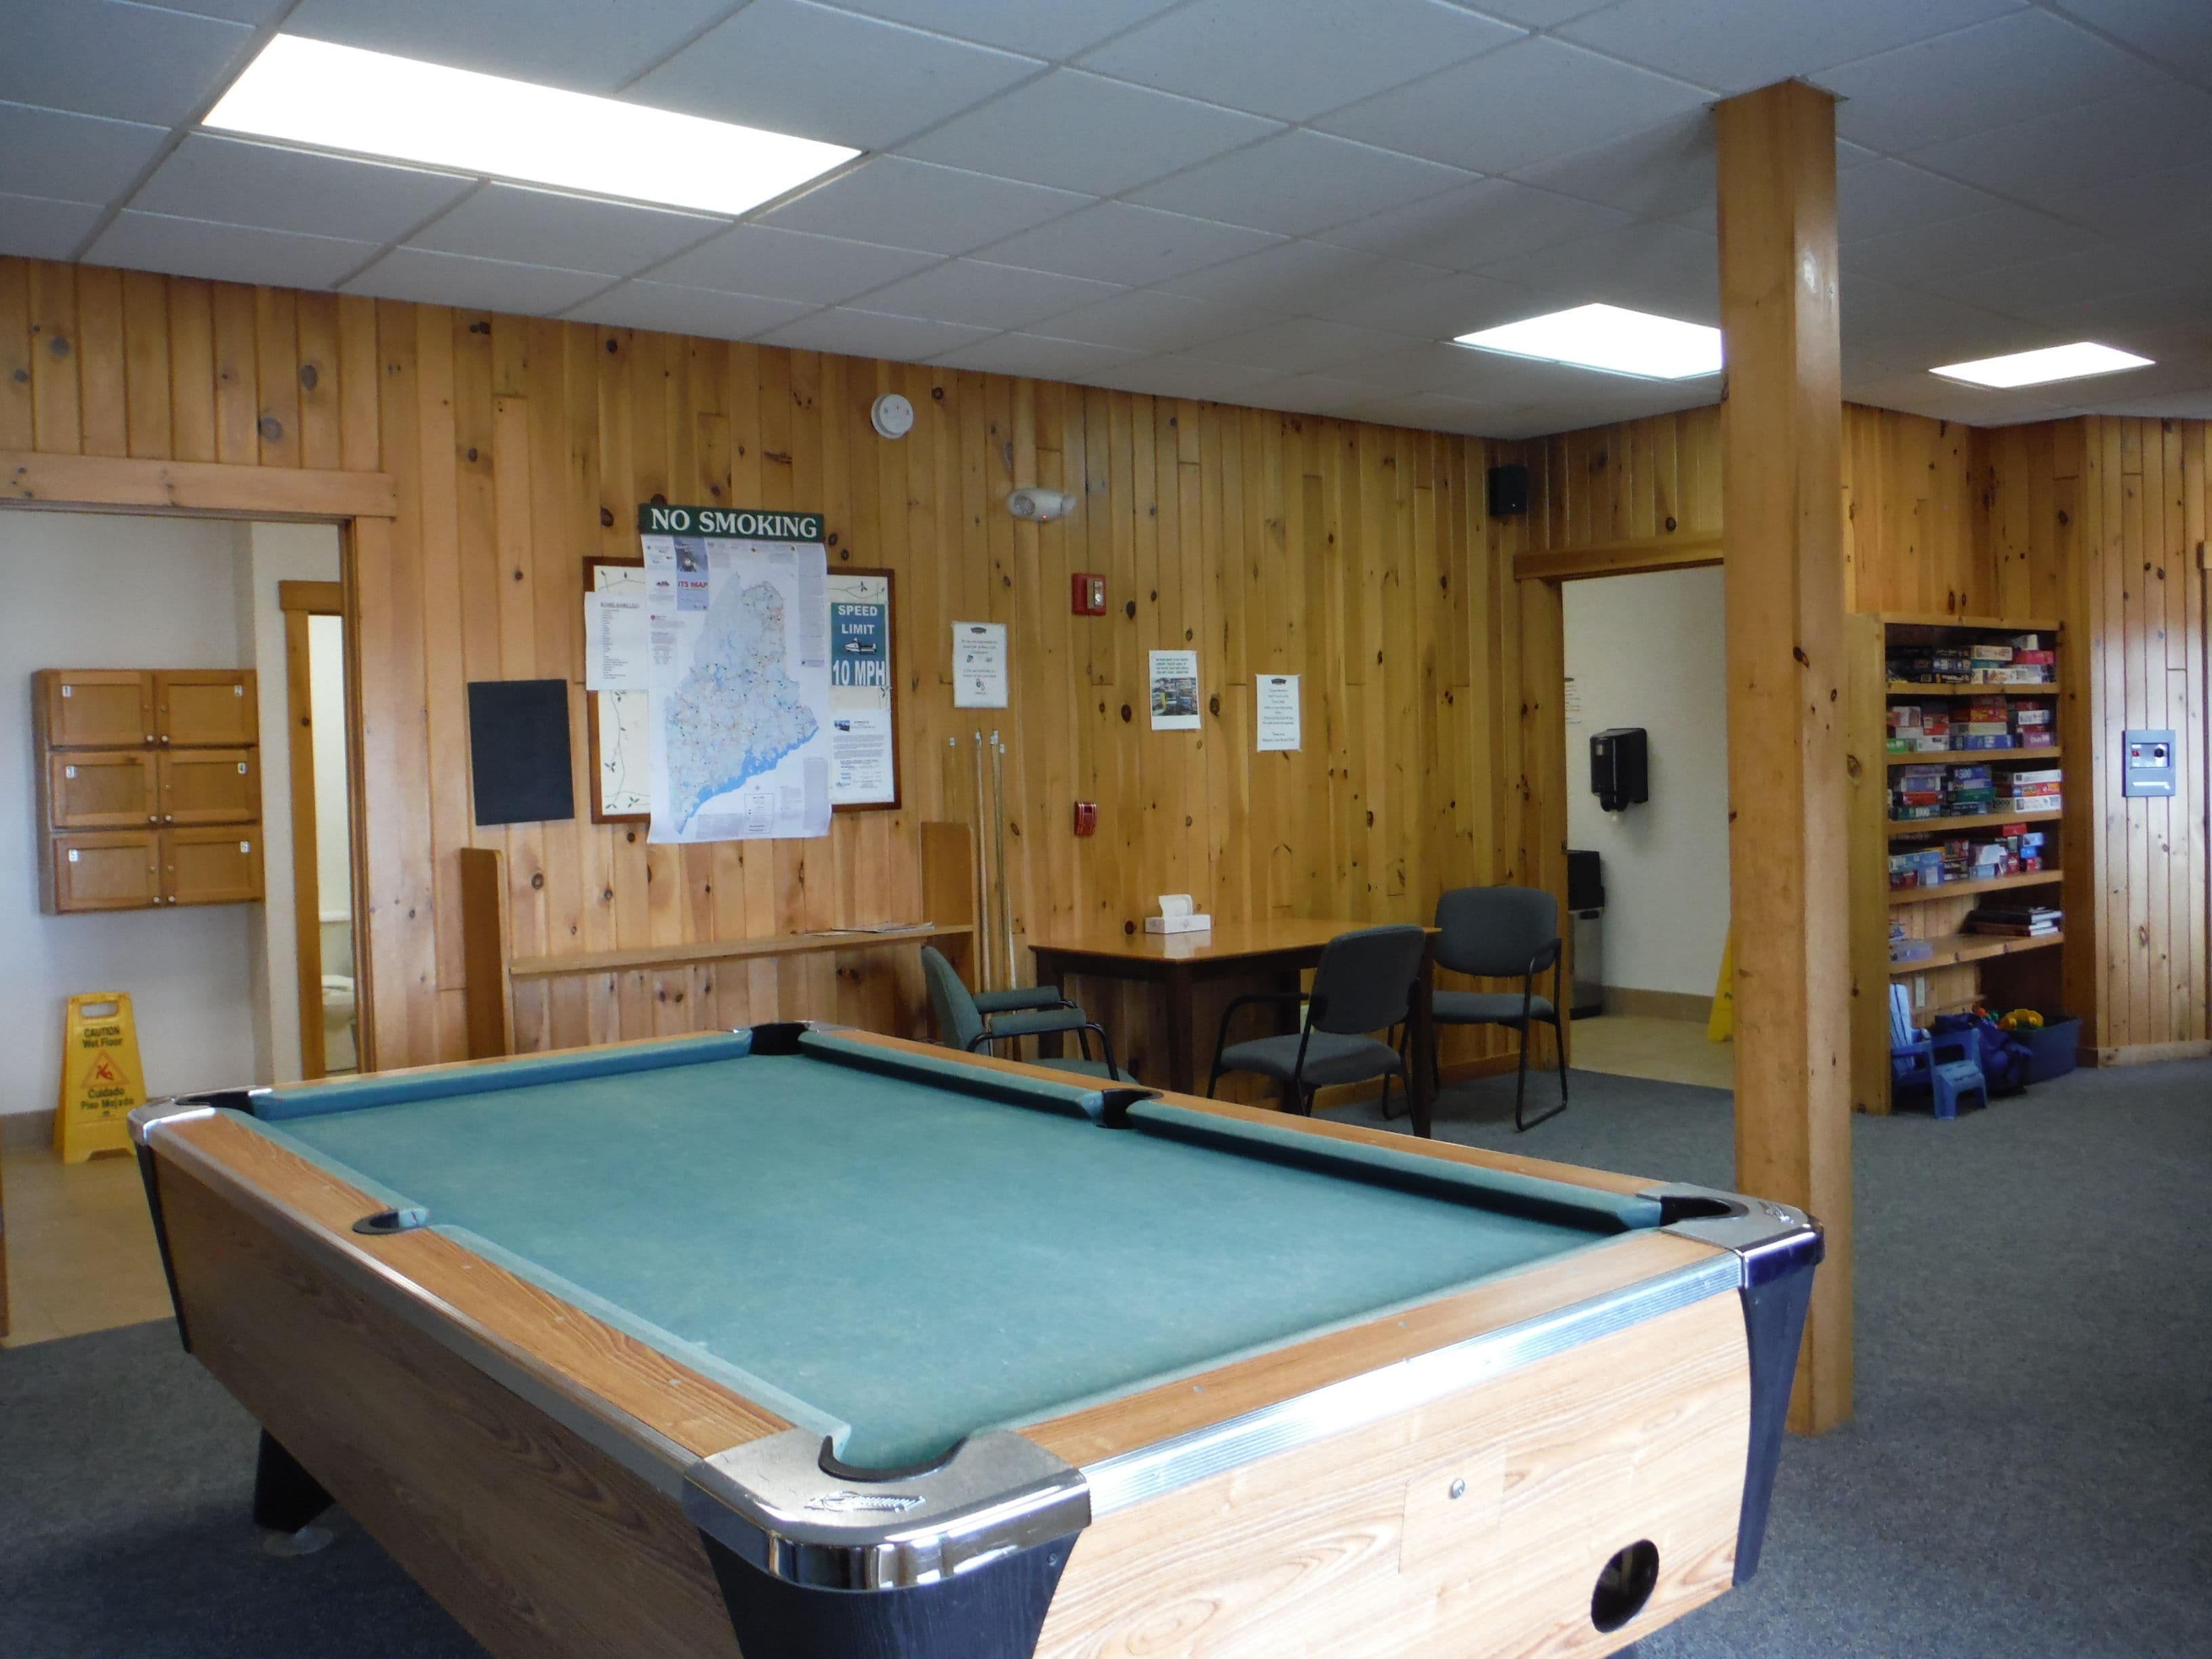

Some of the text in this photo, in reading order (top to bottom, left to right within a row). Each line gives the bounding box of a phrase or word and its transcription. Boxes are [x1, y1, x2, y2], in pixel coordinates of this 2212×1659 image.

[651, 508, 817, 538] NO SMOKING
[838, 605, 878, 616] SPEED
[842, 623, 875, 634] LIMIT
[833, 660, 885, 686] 10 MPH
[84, 1026, 120, 1038] CAUTION
[101, 1038, 123, 1046] Floor
[87, 1086, 125, 1098] Cuidado
